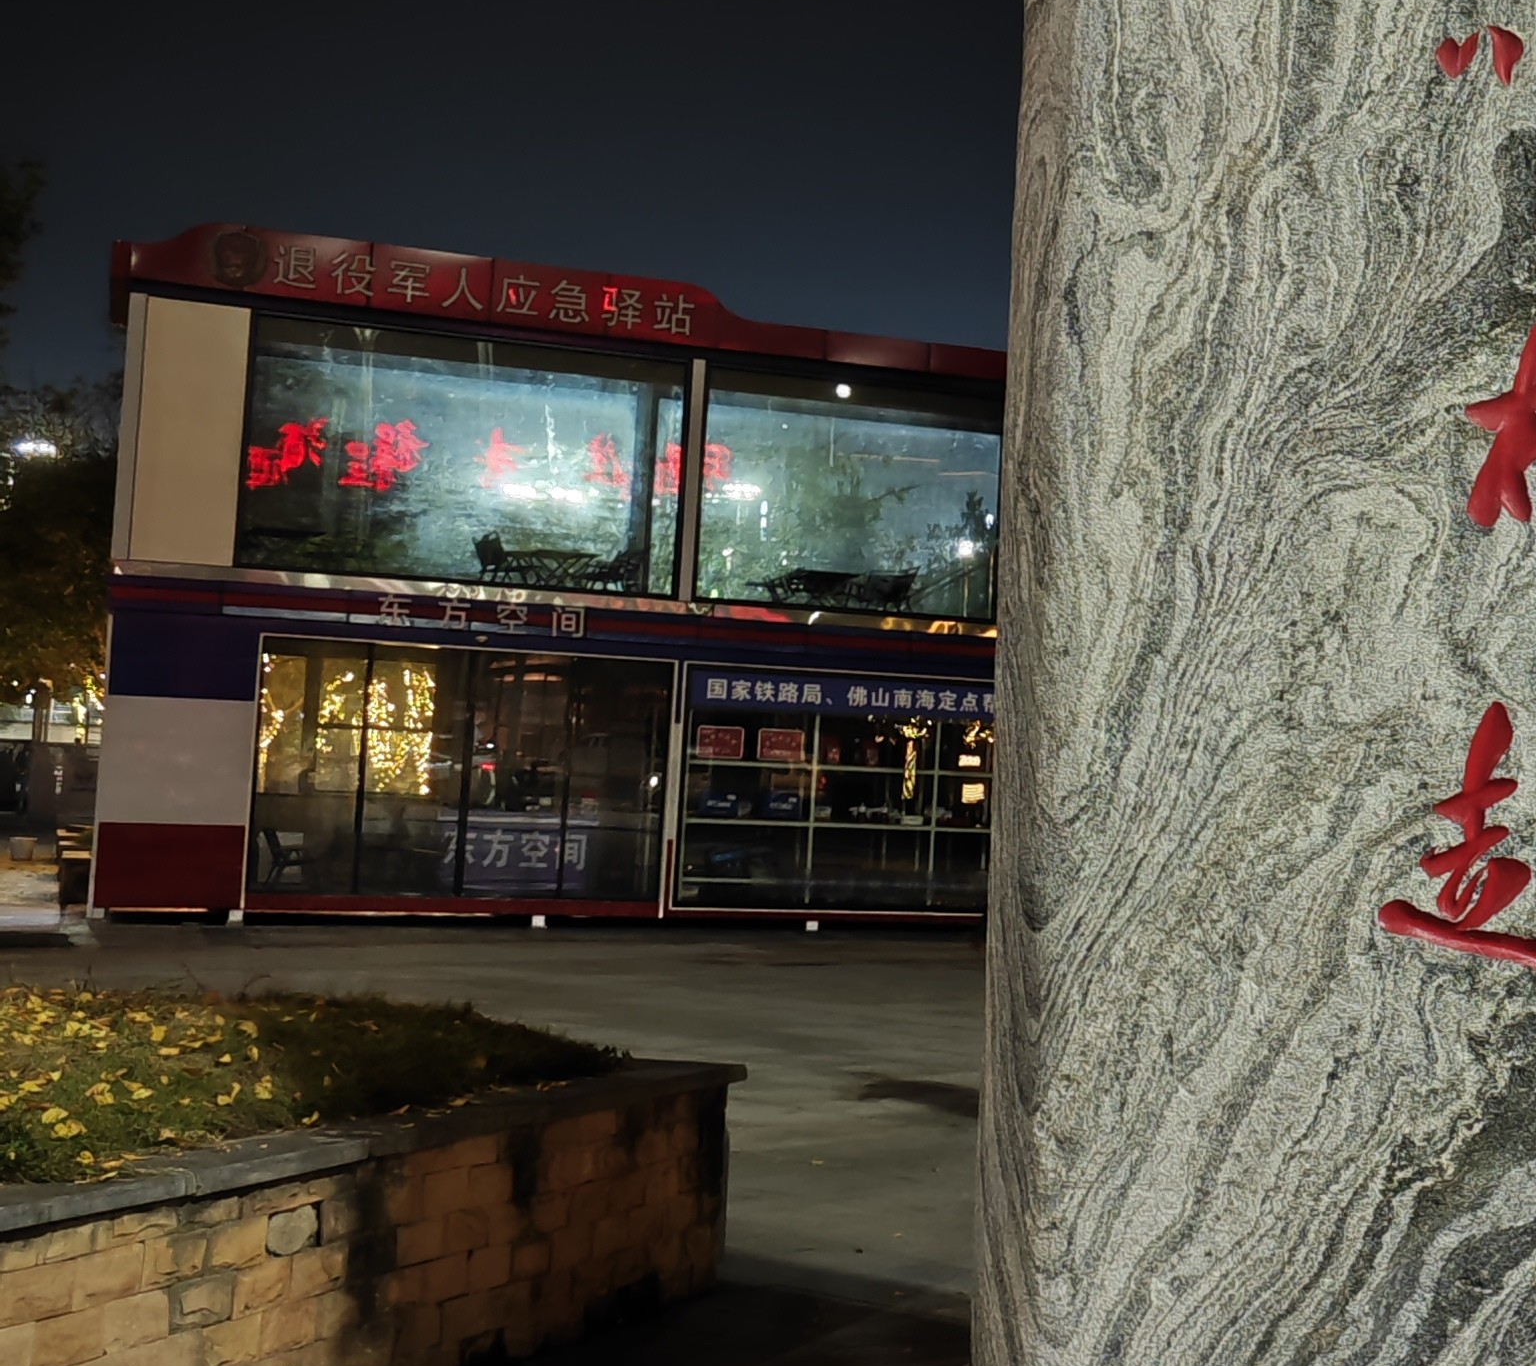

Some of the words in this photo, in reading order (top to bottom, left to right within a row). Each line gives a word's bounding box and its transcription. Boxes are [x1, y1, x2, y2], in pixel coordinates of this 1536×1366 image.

[273, 244, 696, 336] 退役军人应急驿站
[377, 594, 586, 639] 东方空间
[442, 828, 588, 872] 东方空间
